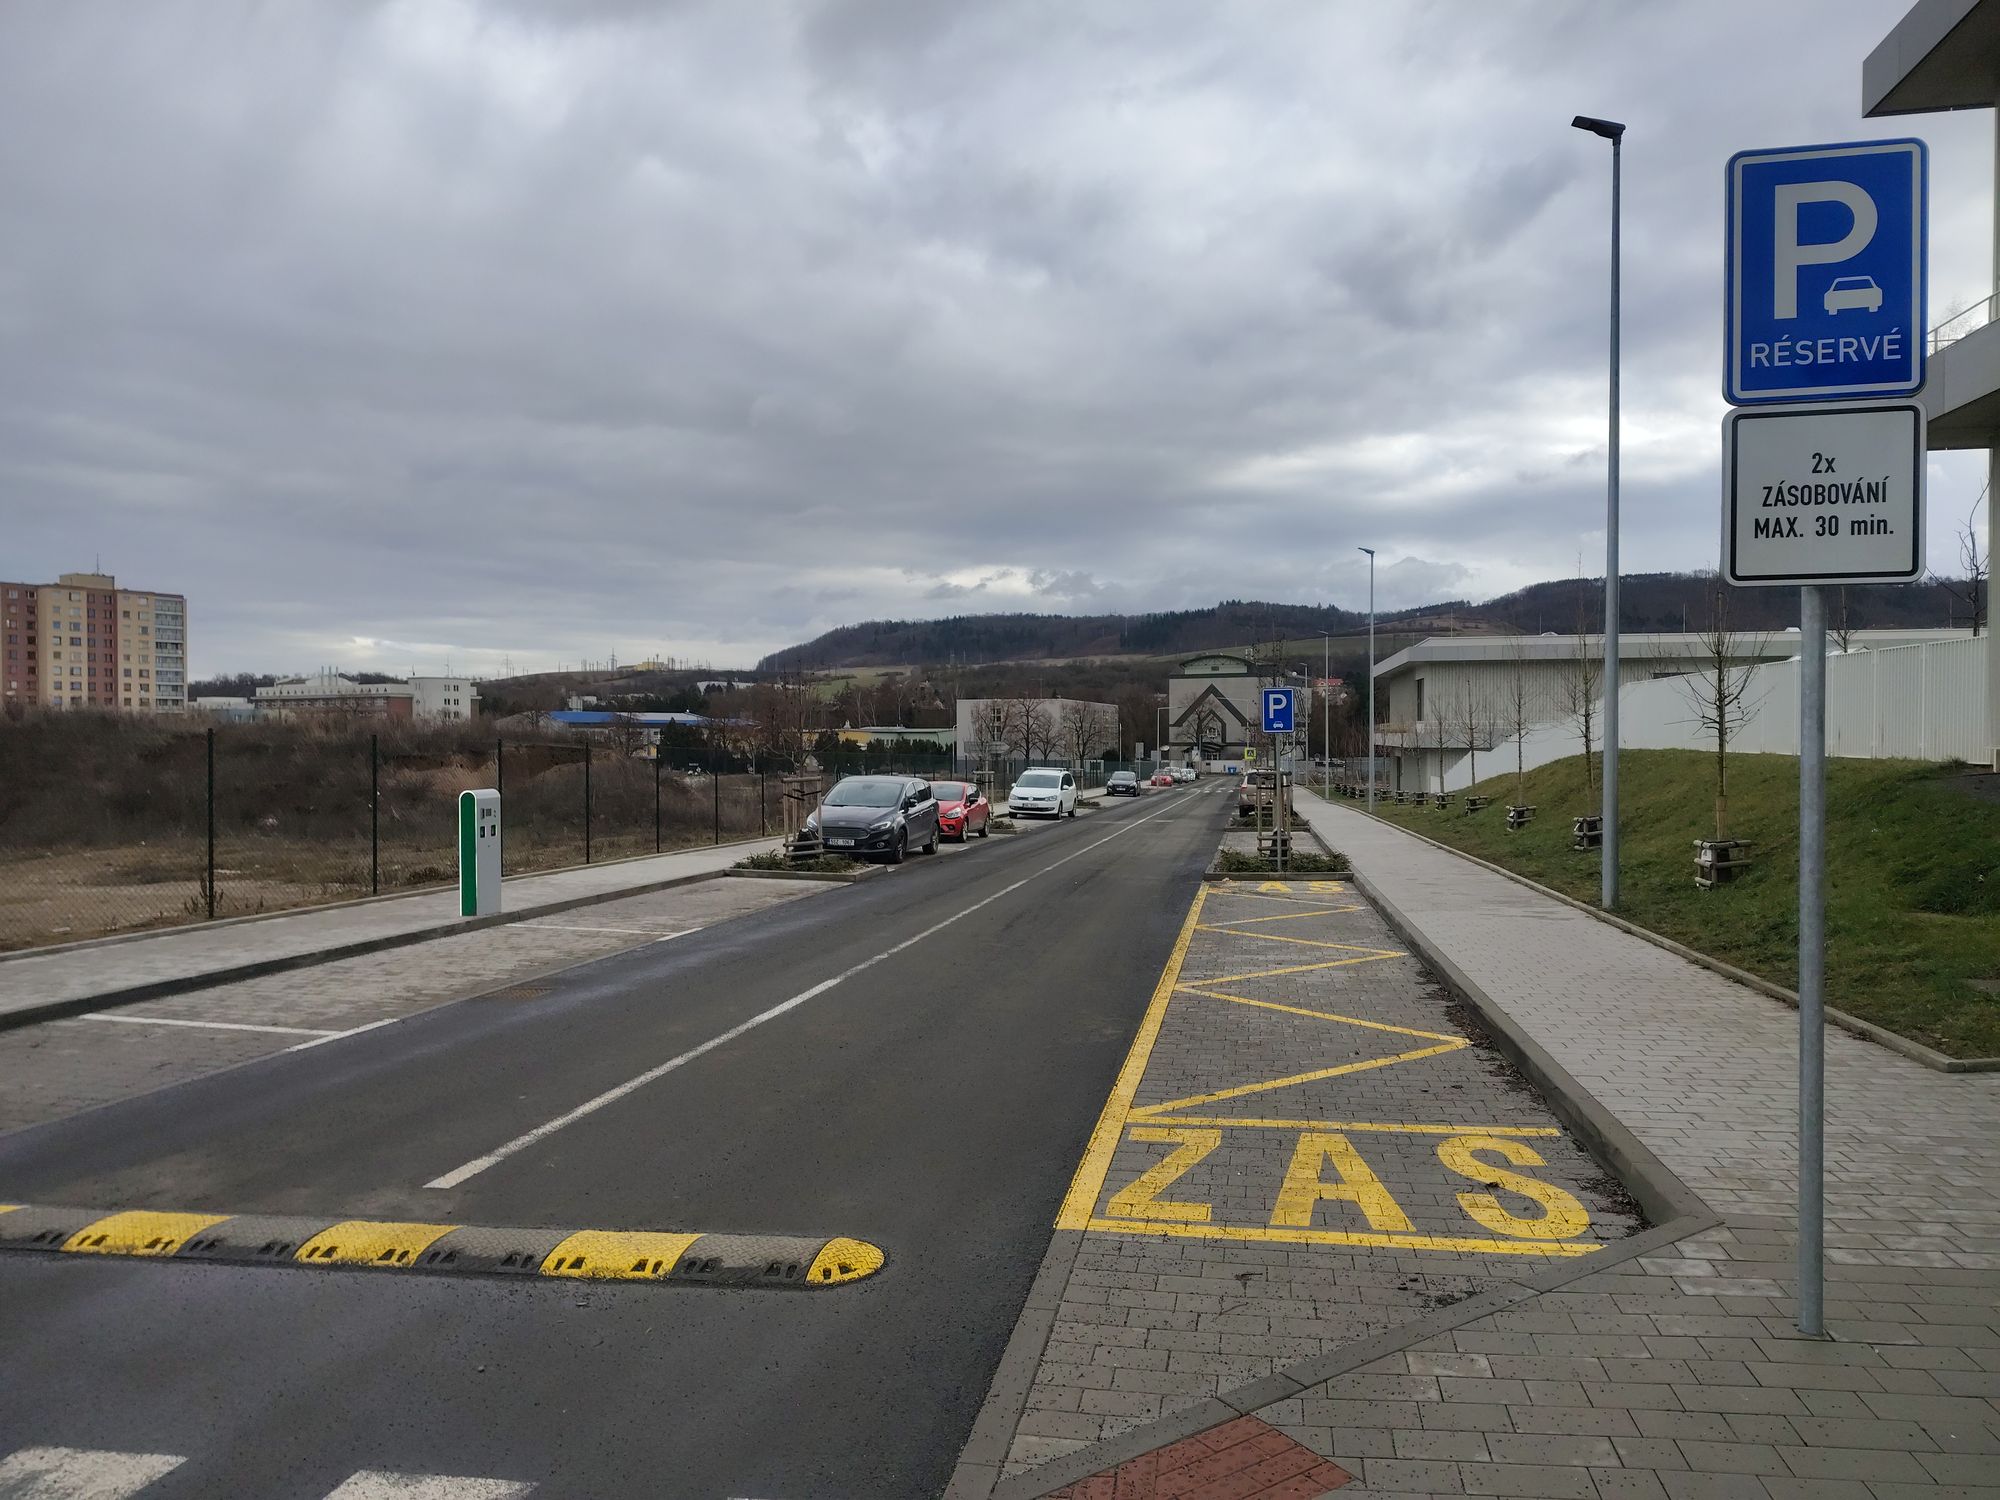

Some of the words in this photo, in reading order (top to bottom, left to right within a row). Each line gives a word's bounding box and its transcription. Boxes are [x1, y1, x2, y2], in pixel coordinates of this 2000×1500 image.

[1774, 180, 1878, 320] P
[1750, 328, 1902, 369] RÉSERVÉ
[1811, 451, 1836, 475] 2x
[1760, 475, 1888, 508] ZÁSOBOVÁNÍ
[1754, 515, 1805, 540] MAX.
[1814, 514, 1840, 538] 30
[1850, 513, 1895, 536] min.
[1268, 693, 1287, 719] P
[1105, 1127, 1590, 1239] ZAS
